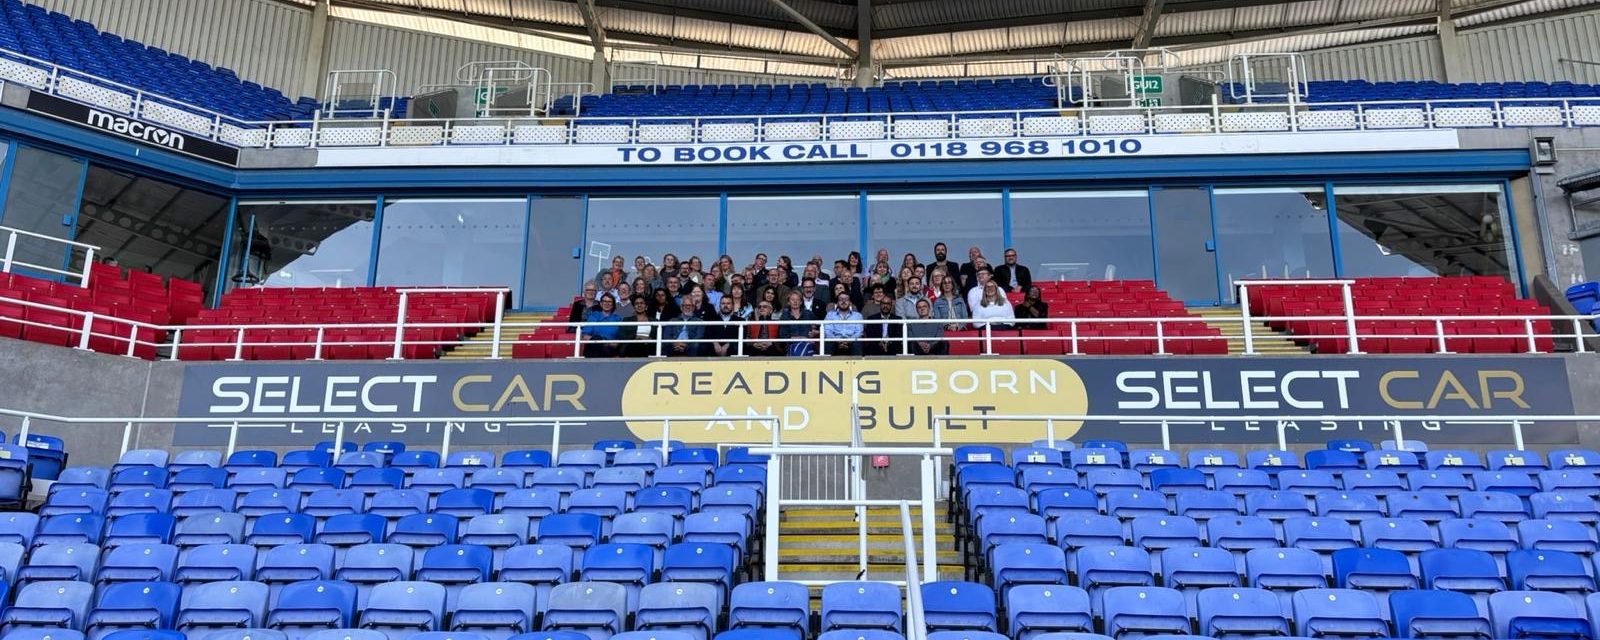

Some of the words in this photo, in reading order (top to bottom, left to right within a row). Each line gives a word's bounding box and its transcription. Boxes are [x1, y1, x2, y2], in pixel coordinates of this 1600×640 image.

[87, 109, 185, 149] macron
[617, 147, 661, 162] TO
[674, 146, 771, 162] BOOK
[782, 144, 868, 160] CALL
[890, 143, 967, 158] 0118
[980, 140, 1049, 156] 968
[1062, 139, 1142, 154] 1010
[209, 375, 437, 413] SELECT
[452, 374, 587, 412] CAR
[653, 370, 881, 396] READING
[911, 370, 1057, 395] BORN
[1115, 370, 1360, 409] SELECT
[1378, 369, 1531, 409] CAR
[704, 405, 810, 431] AND
[851, 405, 996, 431] BUILT
